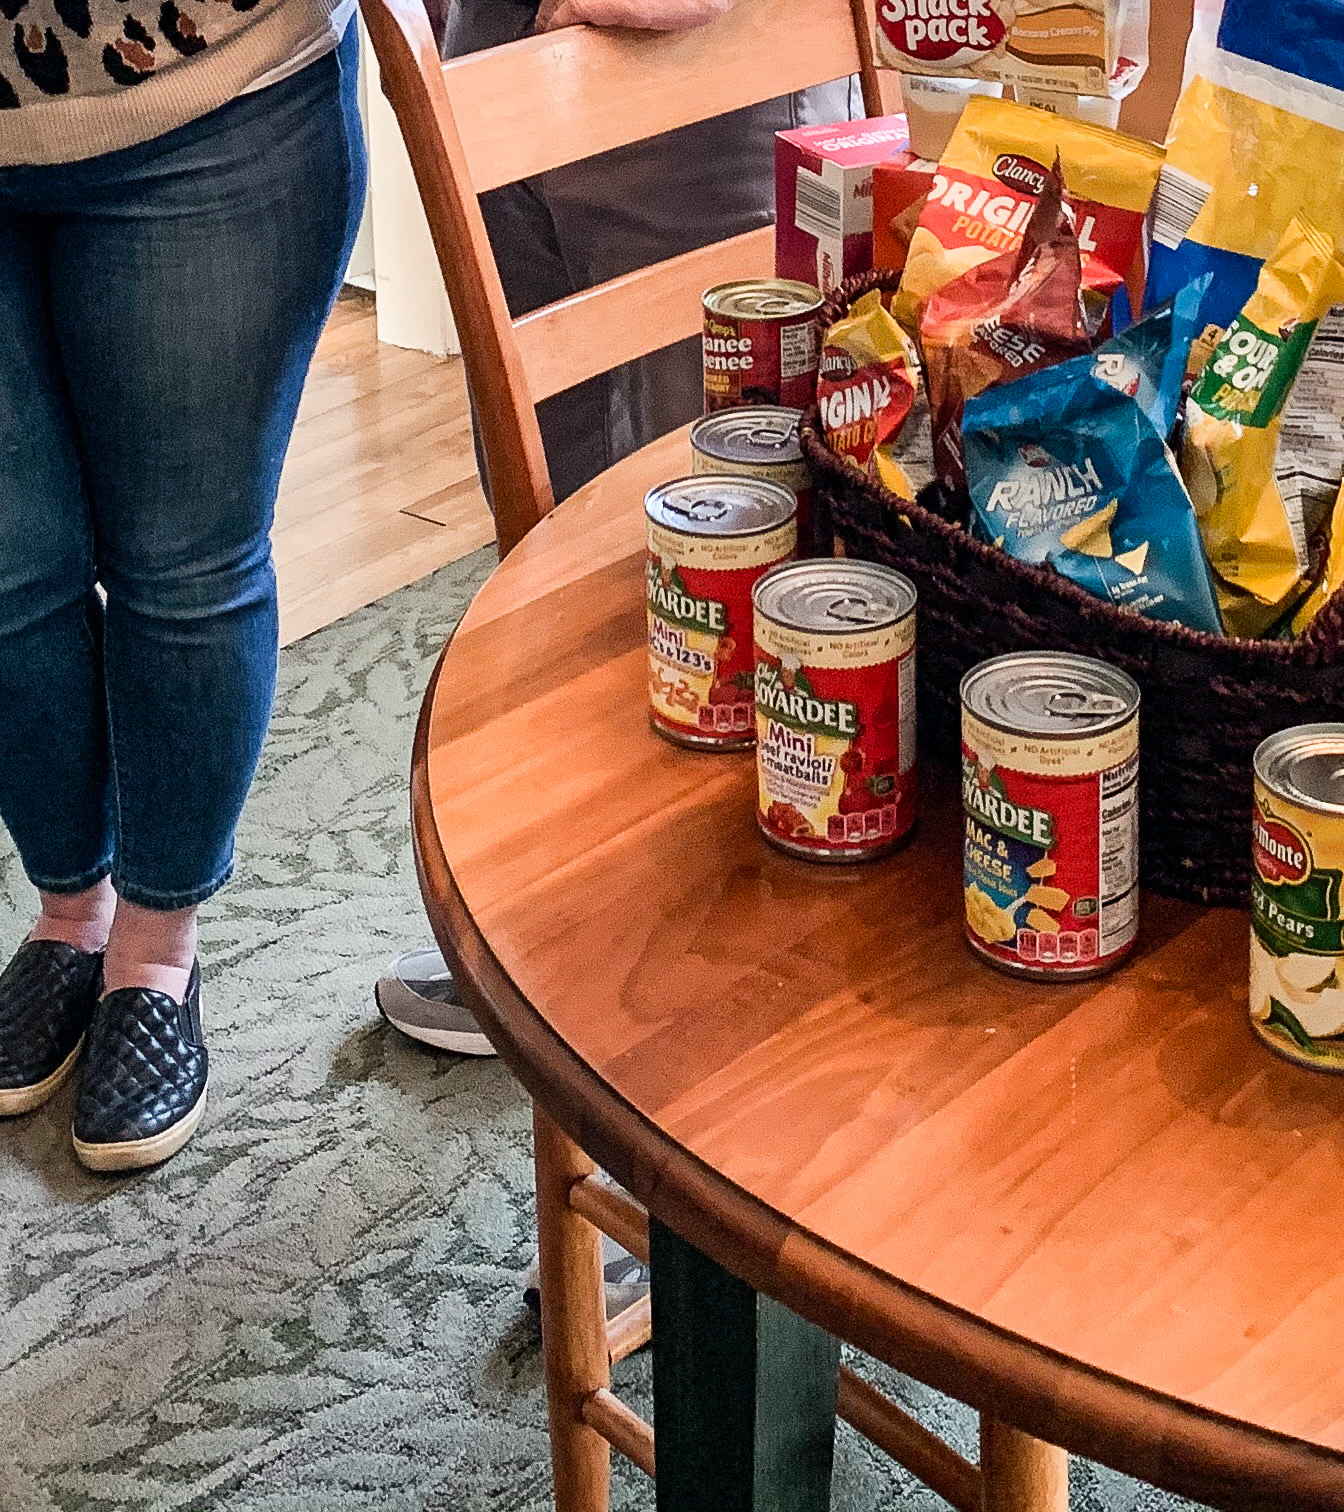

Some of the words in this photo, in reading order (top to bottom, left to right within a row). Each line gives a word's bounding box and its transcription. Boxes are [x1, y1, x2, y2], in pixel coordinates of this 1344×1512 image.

[904, 15, 993, 52] pack
[1011, 25, 1050, 39] Banana
[1083, 25, 1099, 37] Pie
[991, 155, 1046, 194] Clancy
[704, 337, 753, 353] anee
[704, 355, 755, 370] enee
[985, 457, 1104, 513] RANCH
[1005, 494, 1098, 529] FLAVORED
[648, 578, 726, 631] YARDEE
[652, 617, 684, 648] Mini
[675, 648, 713, 673] 123's
[755, 681, 856, 734] OYARDEE
[769, 720, 812, 756] Mini
[766, 756, 830, 787] meatballs
[784, 748, 834, 774] ravioli
[963, 777, 1053, 845] YARDEE
[966, 816, 993, 852] MAC
[996, 839, 1008, 860] &
[964, 838, 1013, 885] CHEESE
[1267, 902, 1315, 939] Pears
